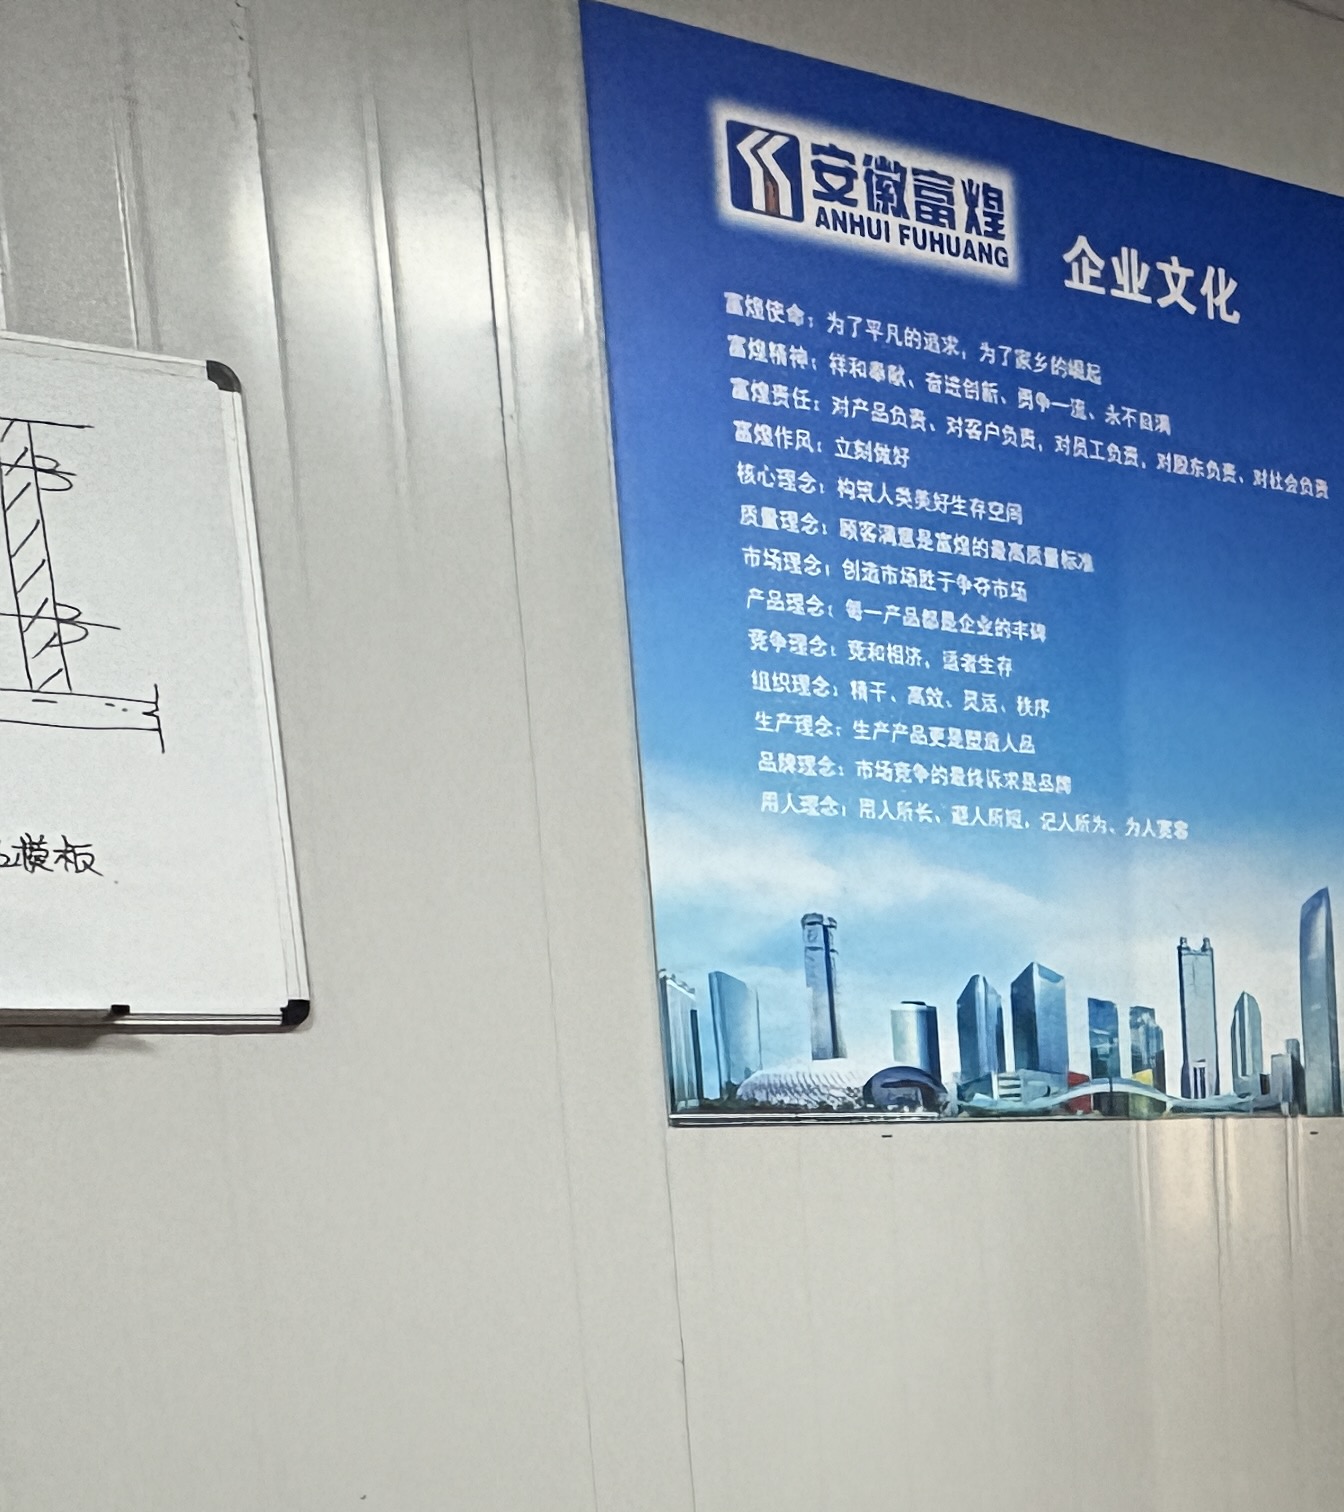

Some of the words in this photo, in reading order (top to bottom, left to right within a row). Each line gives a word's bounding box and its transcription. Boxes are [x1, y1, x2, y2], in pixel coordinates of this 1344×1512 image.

[810, 143, 1007, 242] 安徽富煌
[814, 205, 892, 246] ANHUI
[899, 223, 1010, 269] FUHUANG
[1062, 235, 1241, 324] 企业文化
